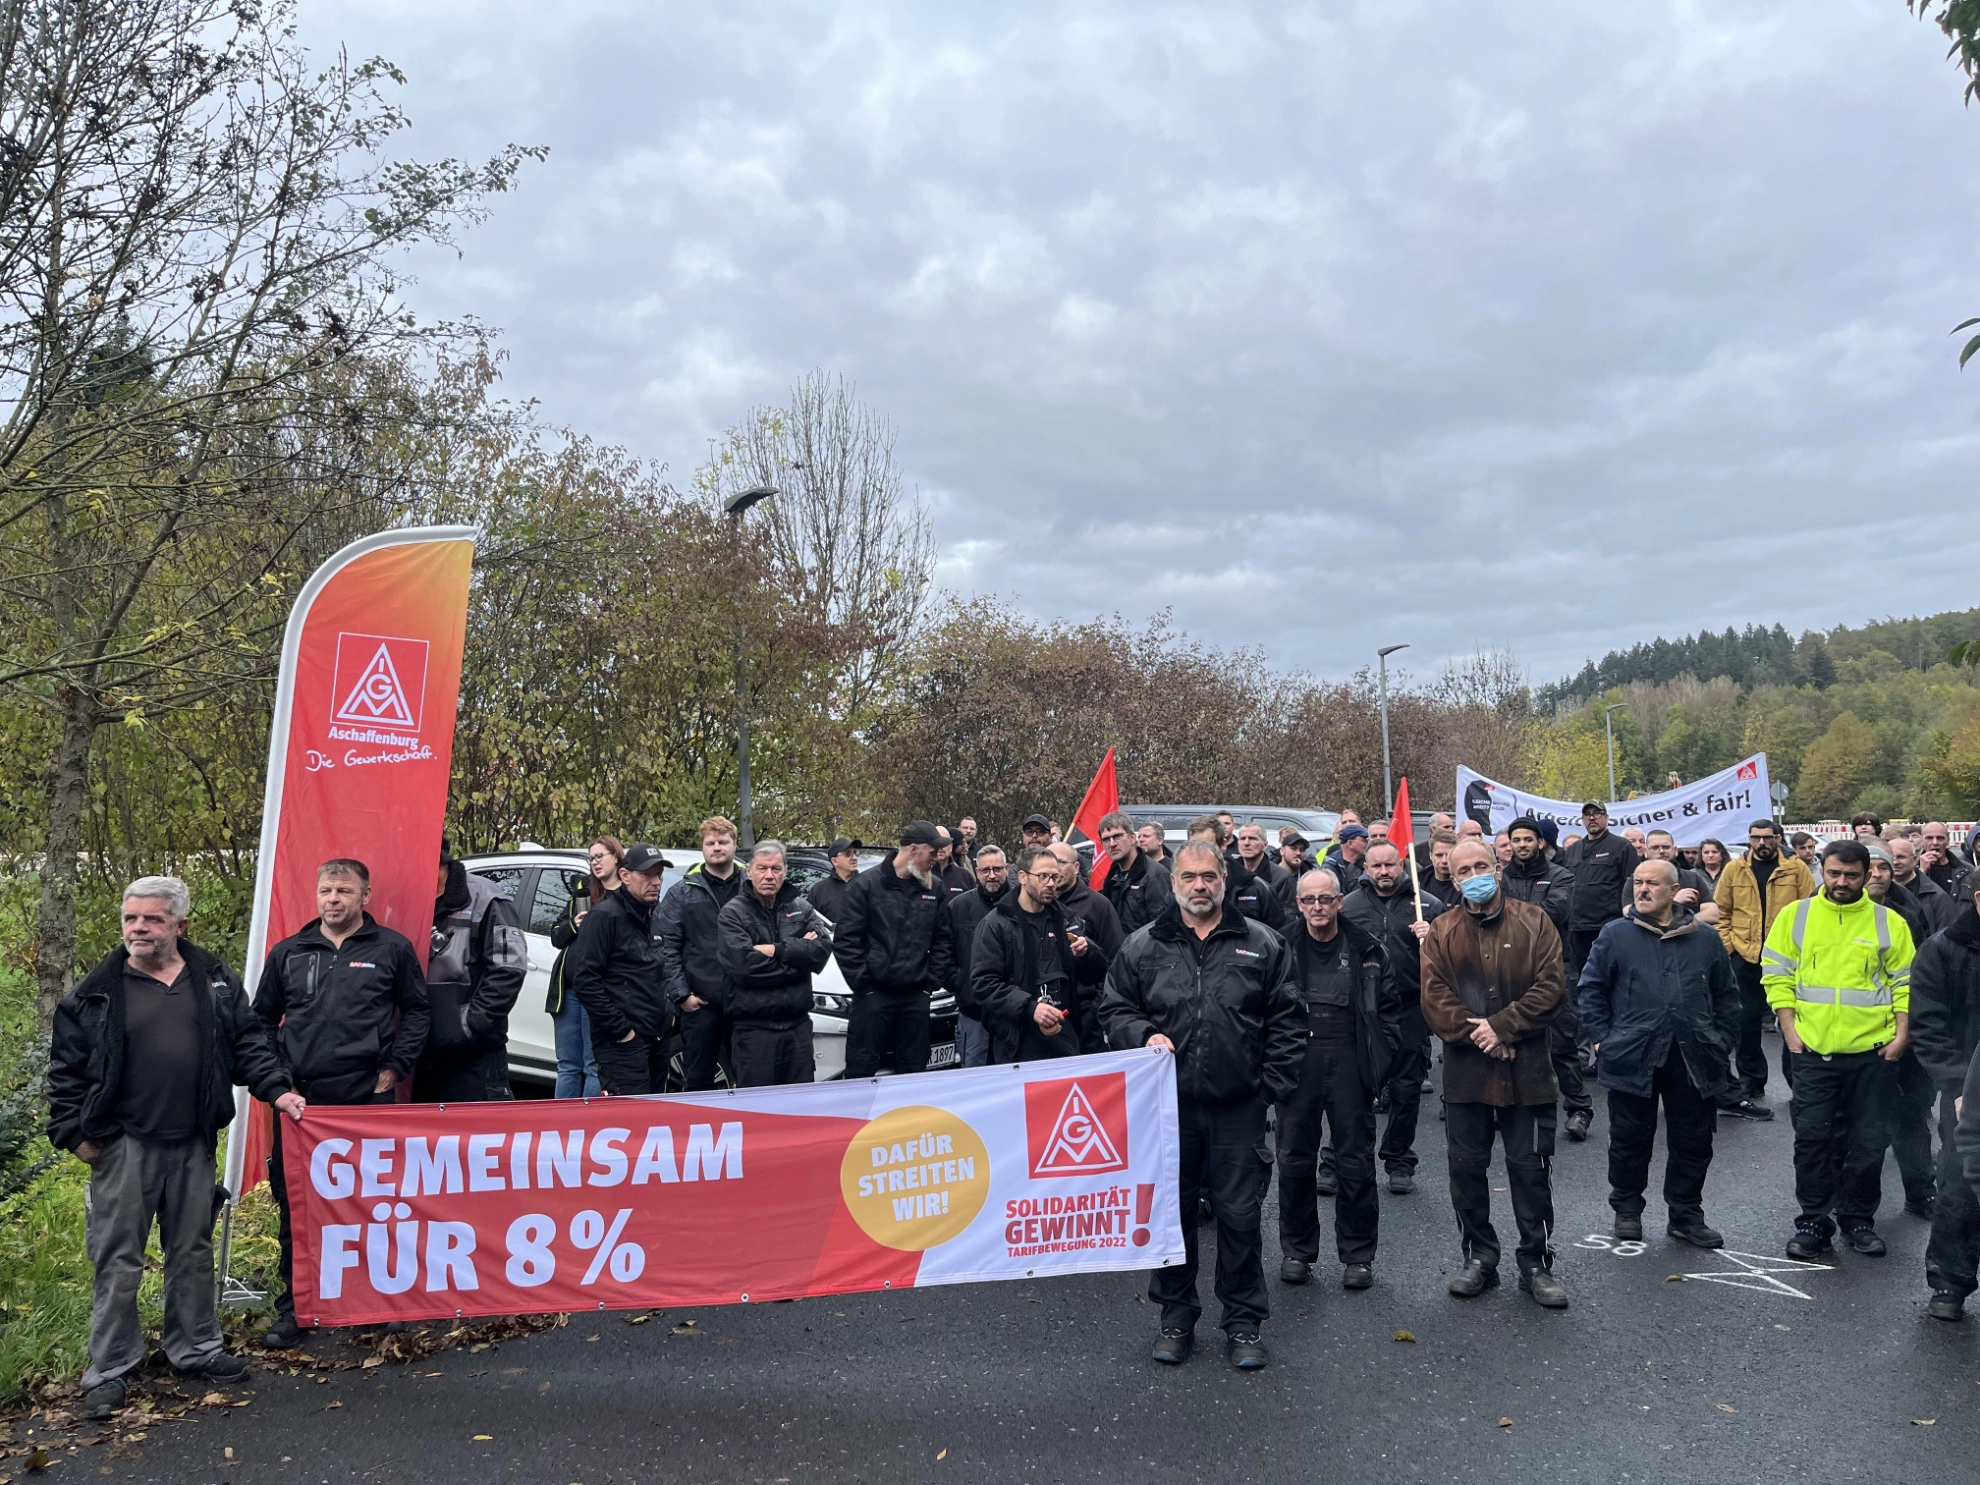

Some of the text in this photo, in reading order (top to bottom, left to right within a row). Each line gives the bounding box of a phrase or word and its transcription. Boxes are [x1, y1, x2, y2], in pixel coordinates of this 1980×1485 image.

[328, 726, 419, 750] Aschaffenburg
[305, 745, 438, 772] Die Gewerkschaft.
[1682, 802, 1699, 817] &
[1707, 789, 1751, 813] fair!
[934, 1046, 954, 1064] 1897
[309, 1121, 744, 1200] GEMEINSAM
[871, 1132, 953, 1168] DAFÜR
[858, 1156, 975, 1197] STREITEN
[892, 1191, 949, 1222] WIR!
[1005, 1185, 1131, 1219] SOLIDARITÄT
[319, 1202, 480, 1300] FÜR
[1007, 1237, 1127, 1257] TARIFBEWEGUNG 2022
